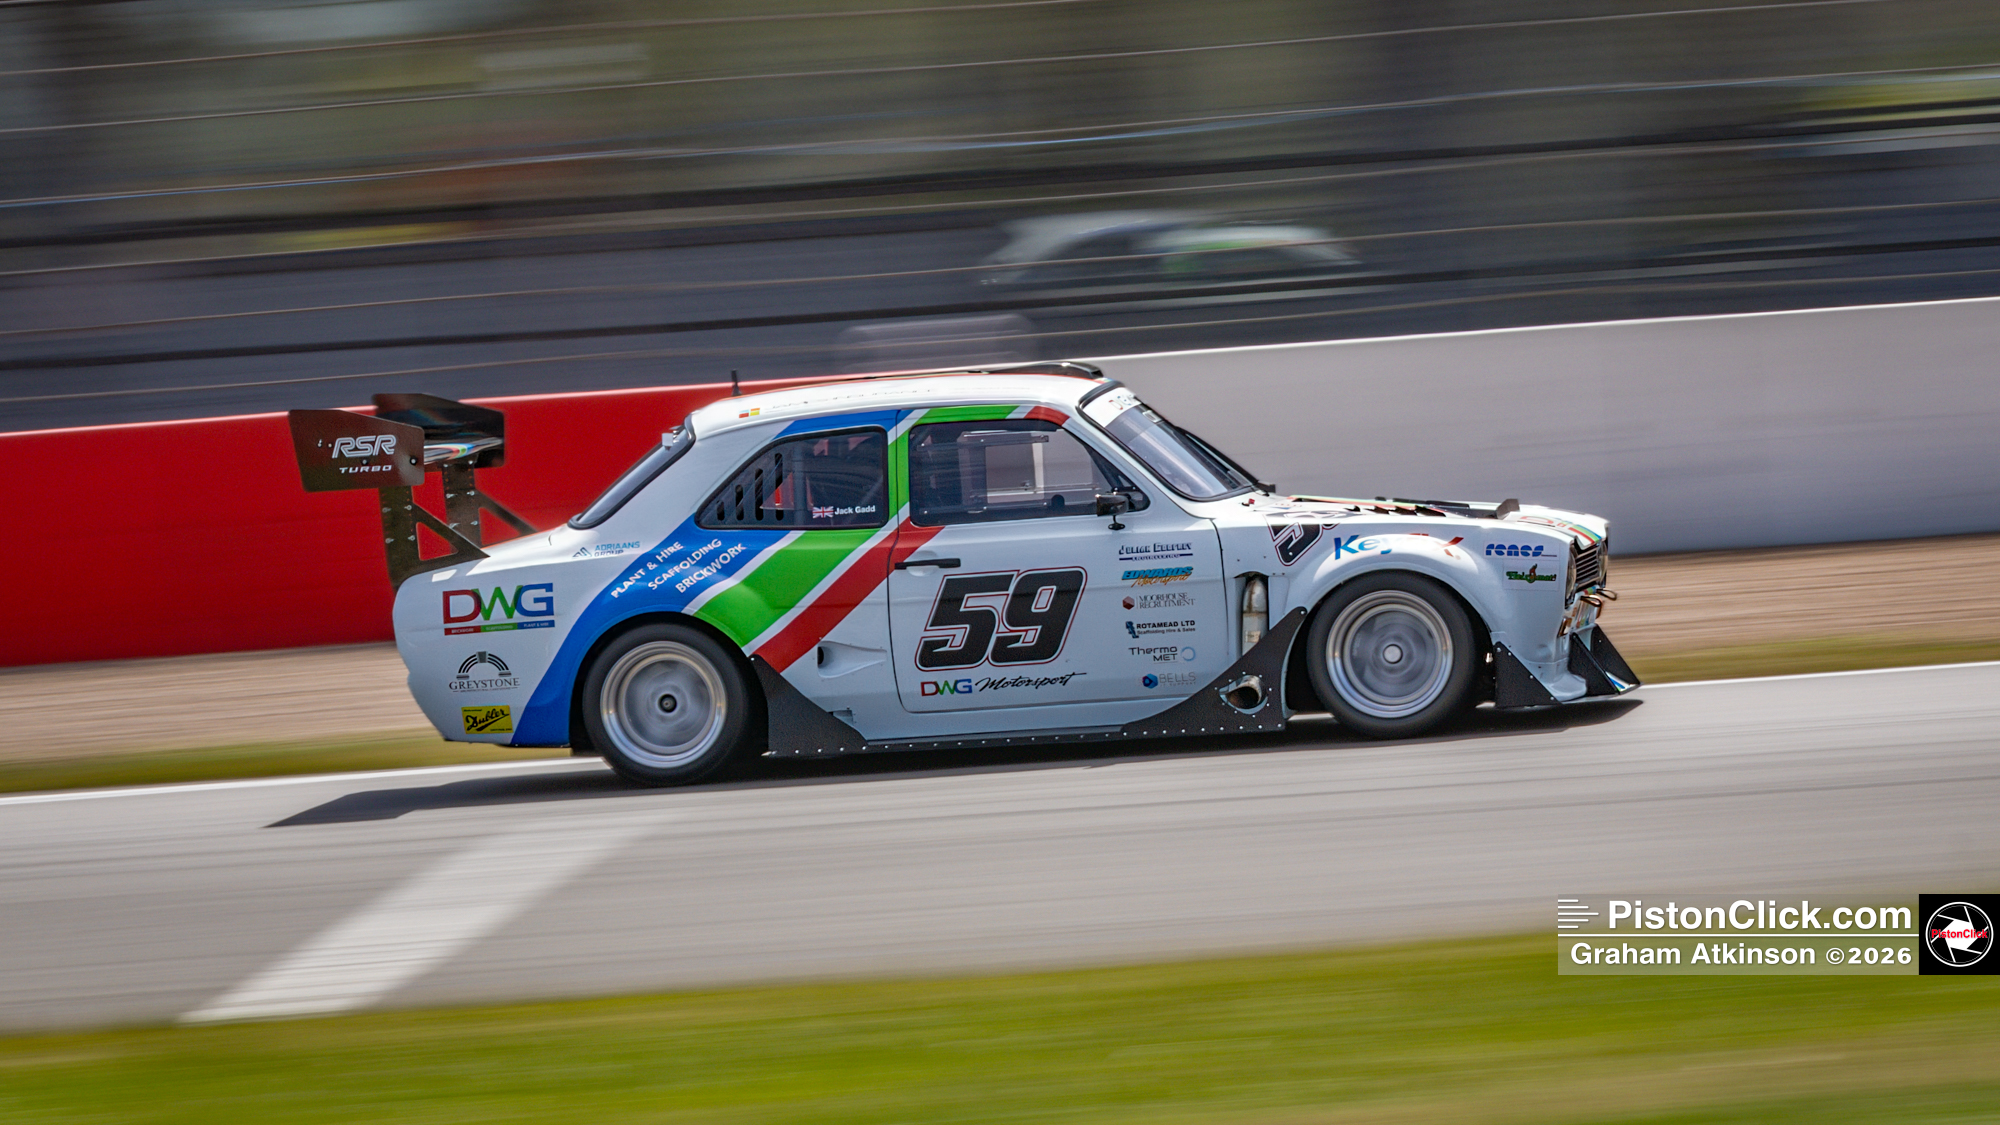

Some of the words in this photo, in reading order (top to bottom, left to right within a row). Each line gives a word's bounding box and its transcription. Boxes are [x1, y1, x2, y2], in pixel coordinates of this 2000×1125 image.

[332, 434, 397, 459] RSR
[339, 465, 392, 474] TURBO
[834, 507, 853, 515] Jack
[855, 505, 876, 514] Gadd
[594, 540, 641, 551] ADRIAANS
[610, 568, 646, 599] PLANT
[646, 561, 659, 571] &
[655, 541, 684, 563] HIRE
[647, 538, 722, 590] SCAFFOLDING
[675, 543, 747, 593] BRICKWORK
[1121, 566, 1194, 580] EDWARDS
[1138, 592, 1188, 601] MOORHOUSE
[442, 582, 555, 625] DWG
[1139, 598, 1195, 609] RECRUITMENT
[914, 566, 1088, 673] 59
[1136, 621, 1179, 629] ROTAMEAD
[1128, 646, 1178, 656] Thermo
[1153, 653, 1178, 662] MET
[1158, 671, 1197, 683] BELLS
[448, 677, 521, 691] GREYSTONE
[920, 678, 973, 697] DWG
[974, 671, 1088, 692] Motorsport
